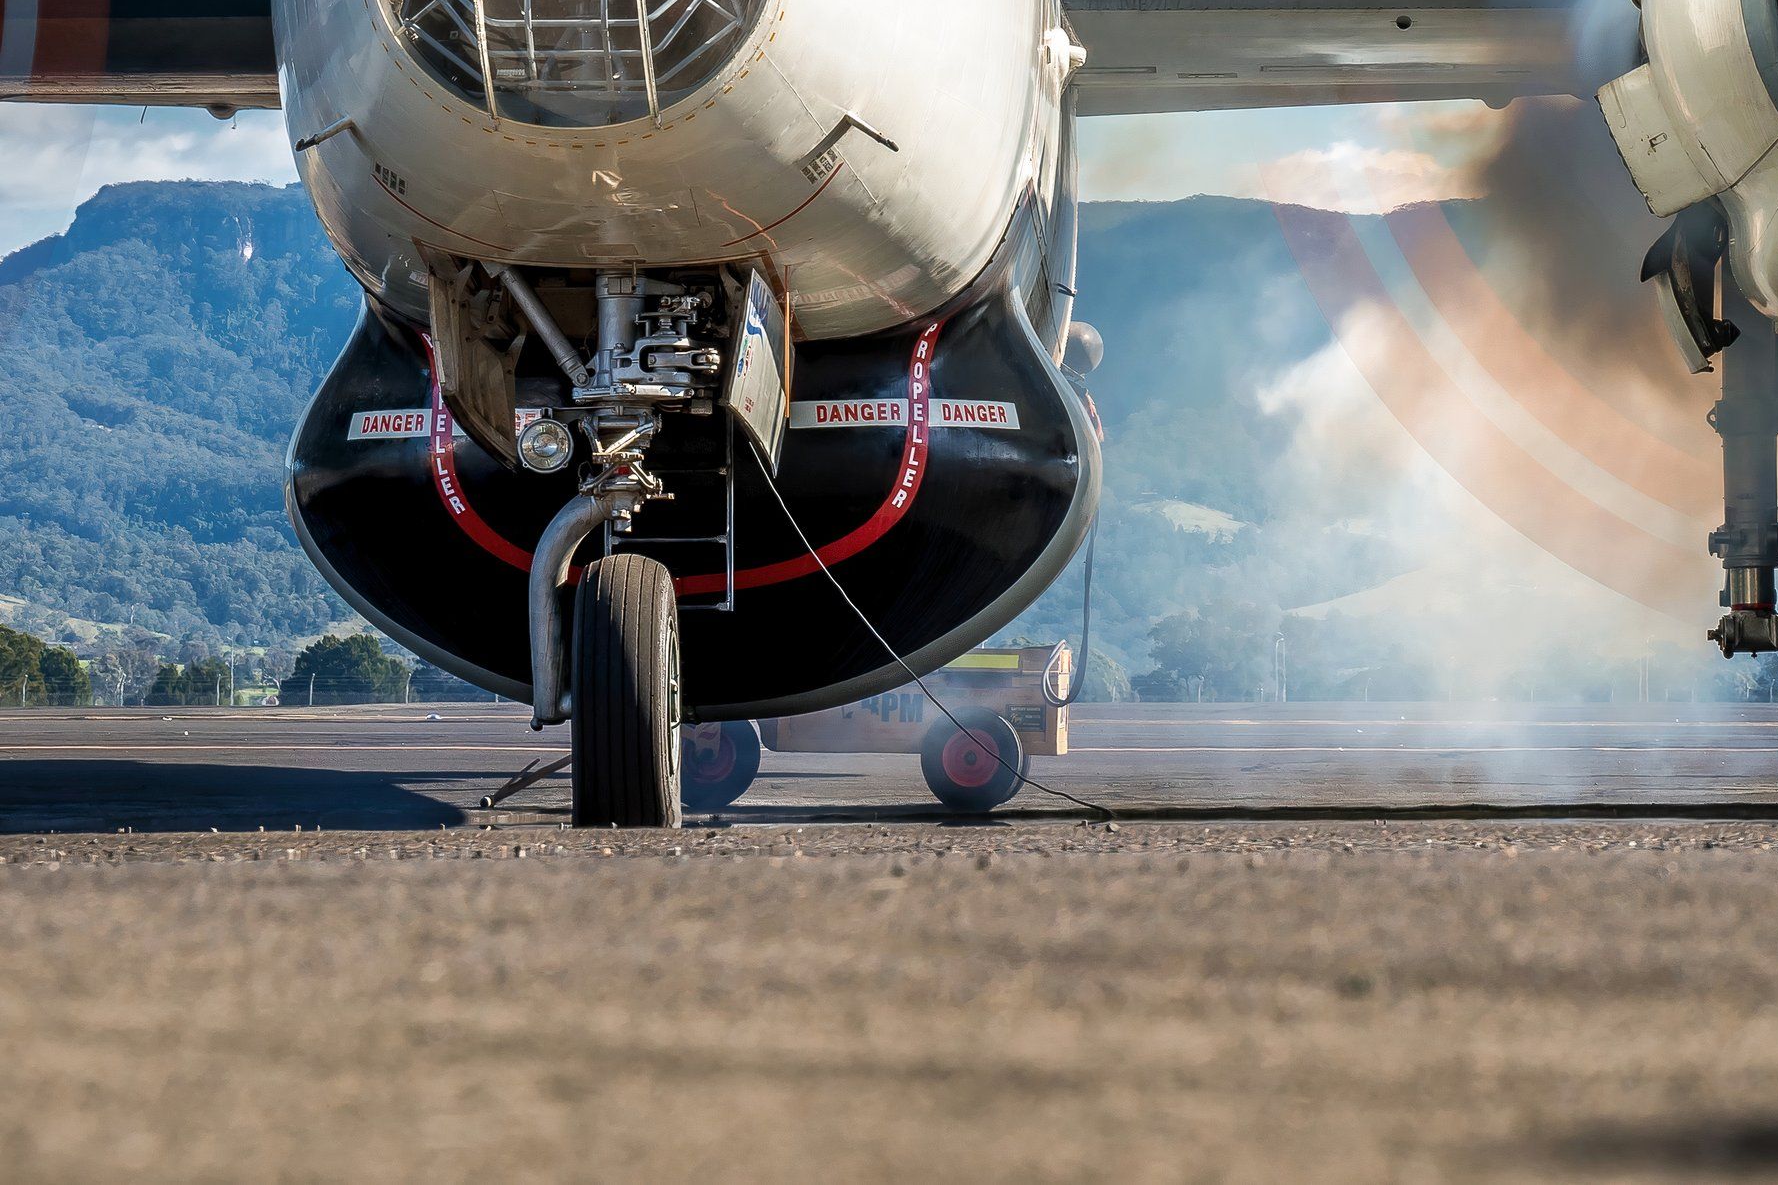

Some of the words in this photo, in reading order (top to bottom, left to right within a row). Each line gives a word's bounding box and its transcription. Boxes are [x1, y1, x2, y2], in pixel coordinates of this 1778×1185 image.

[816, 401, 901, 423] DANGER
[890, 322, 939, 508] PROPELLER
[942, 403, 1007, 424] DANGER
[361, 412, 424, 435] DANGER
